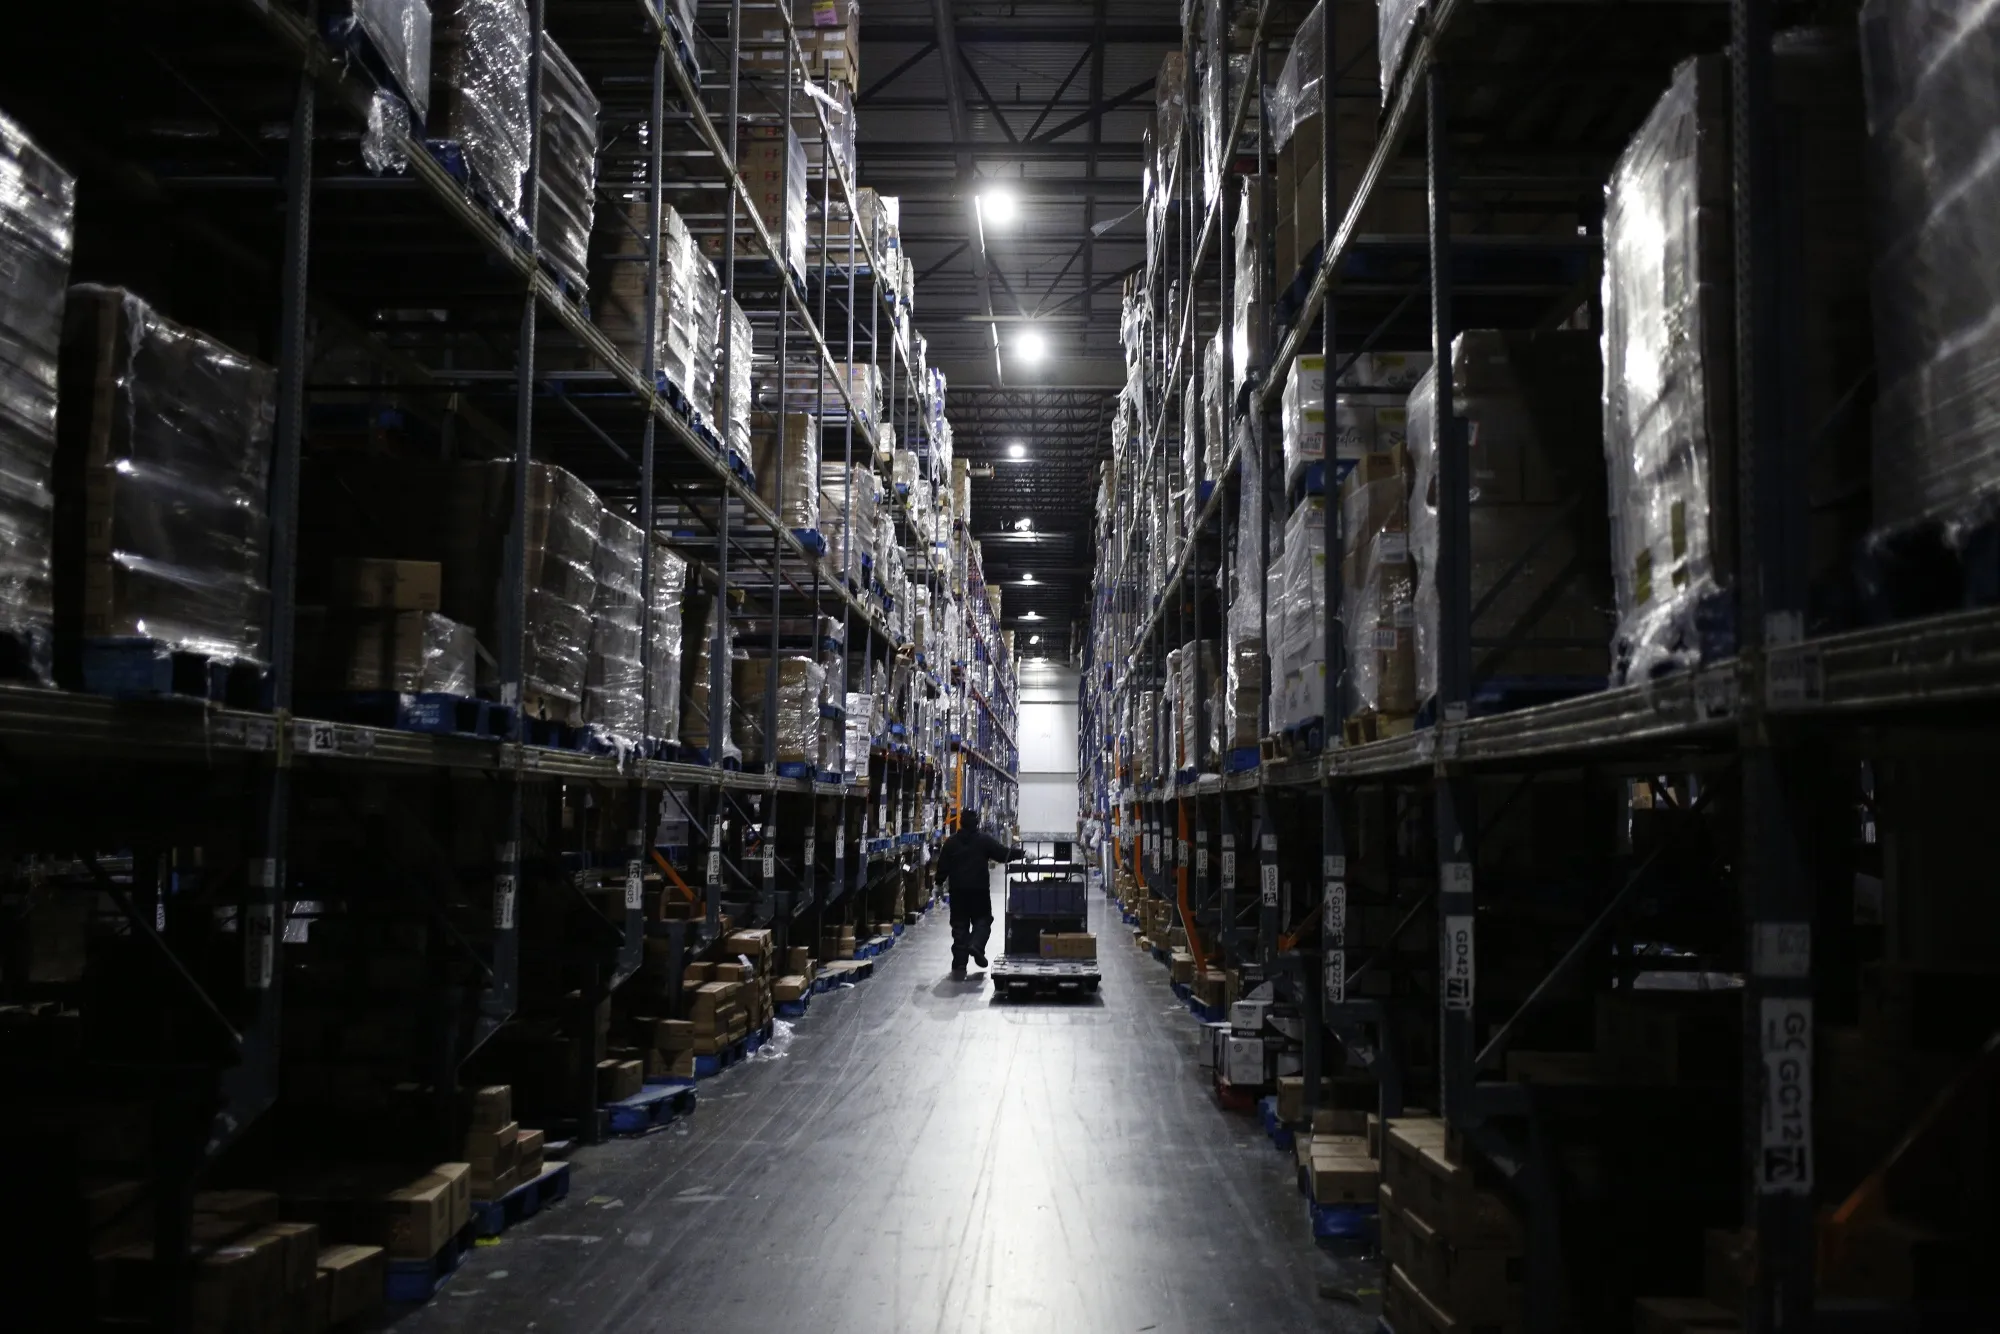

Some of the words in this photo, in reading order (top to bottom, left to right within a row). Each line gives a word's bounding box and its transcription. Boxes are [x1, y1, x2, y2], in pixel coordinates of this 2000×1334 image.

[317, 728, 332, 746] 21
[1332, 895, 1342, 928] GD22
[1456, 929, 1469, 976] GD42
[1778, 1058, 1803, 1141] GC12
